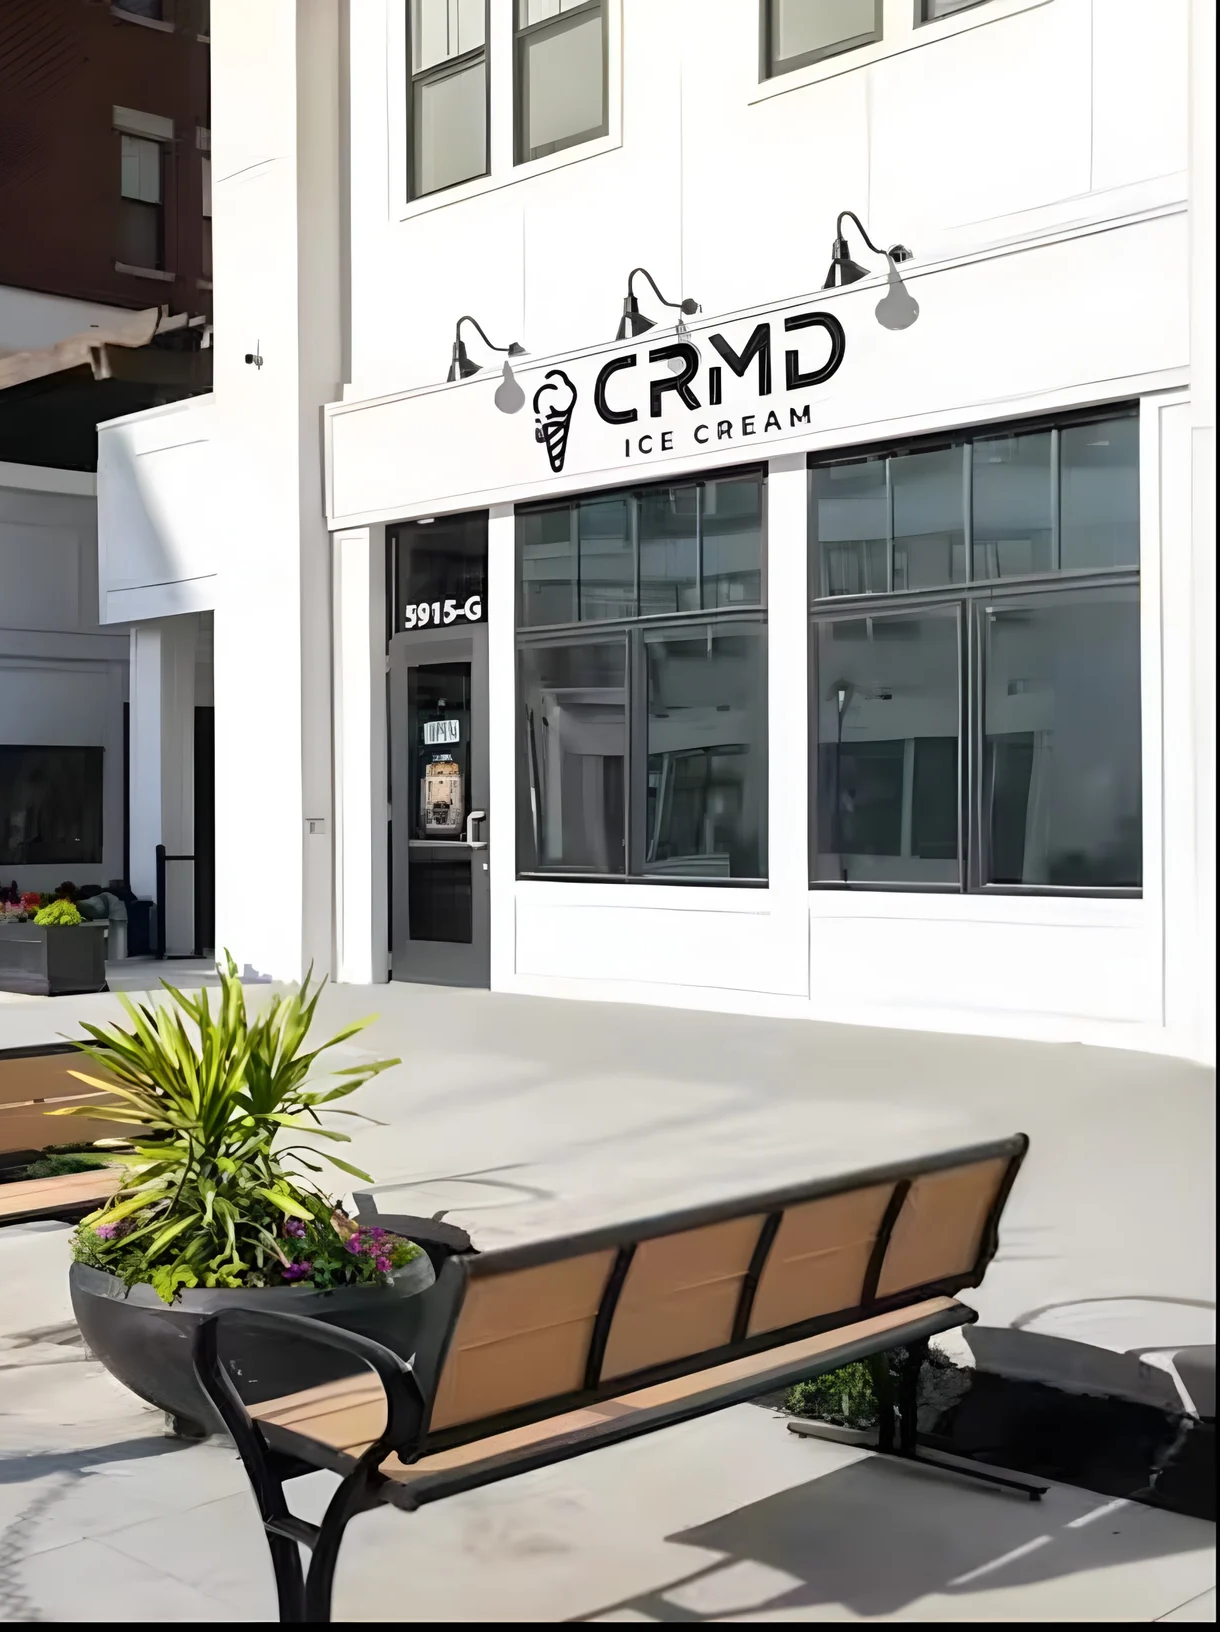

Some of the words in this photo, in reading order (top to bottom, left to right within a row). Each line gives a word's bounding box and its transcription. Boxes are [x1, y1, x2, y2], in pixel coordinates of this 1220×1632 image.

[593, 311, 846, 425] CRMD
[624, 430, 674, 458] ICE
[693, 404, 812, 445] CREAM
[404, 595, 482, 629] 5915-G
